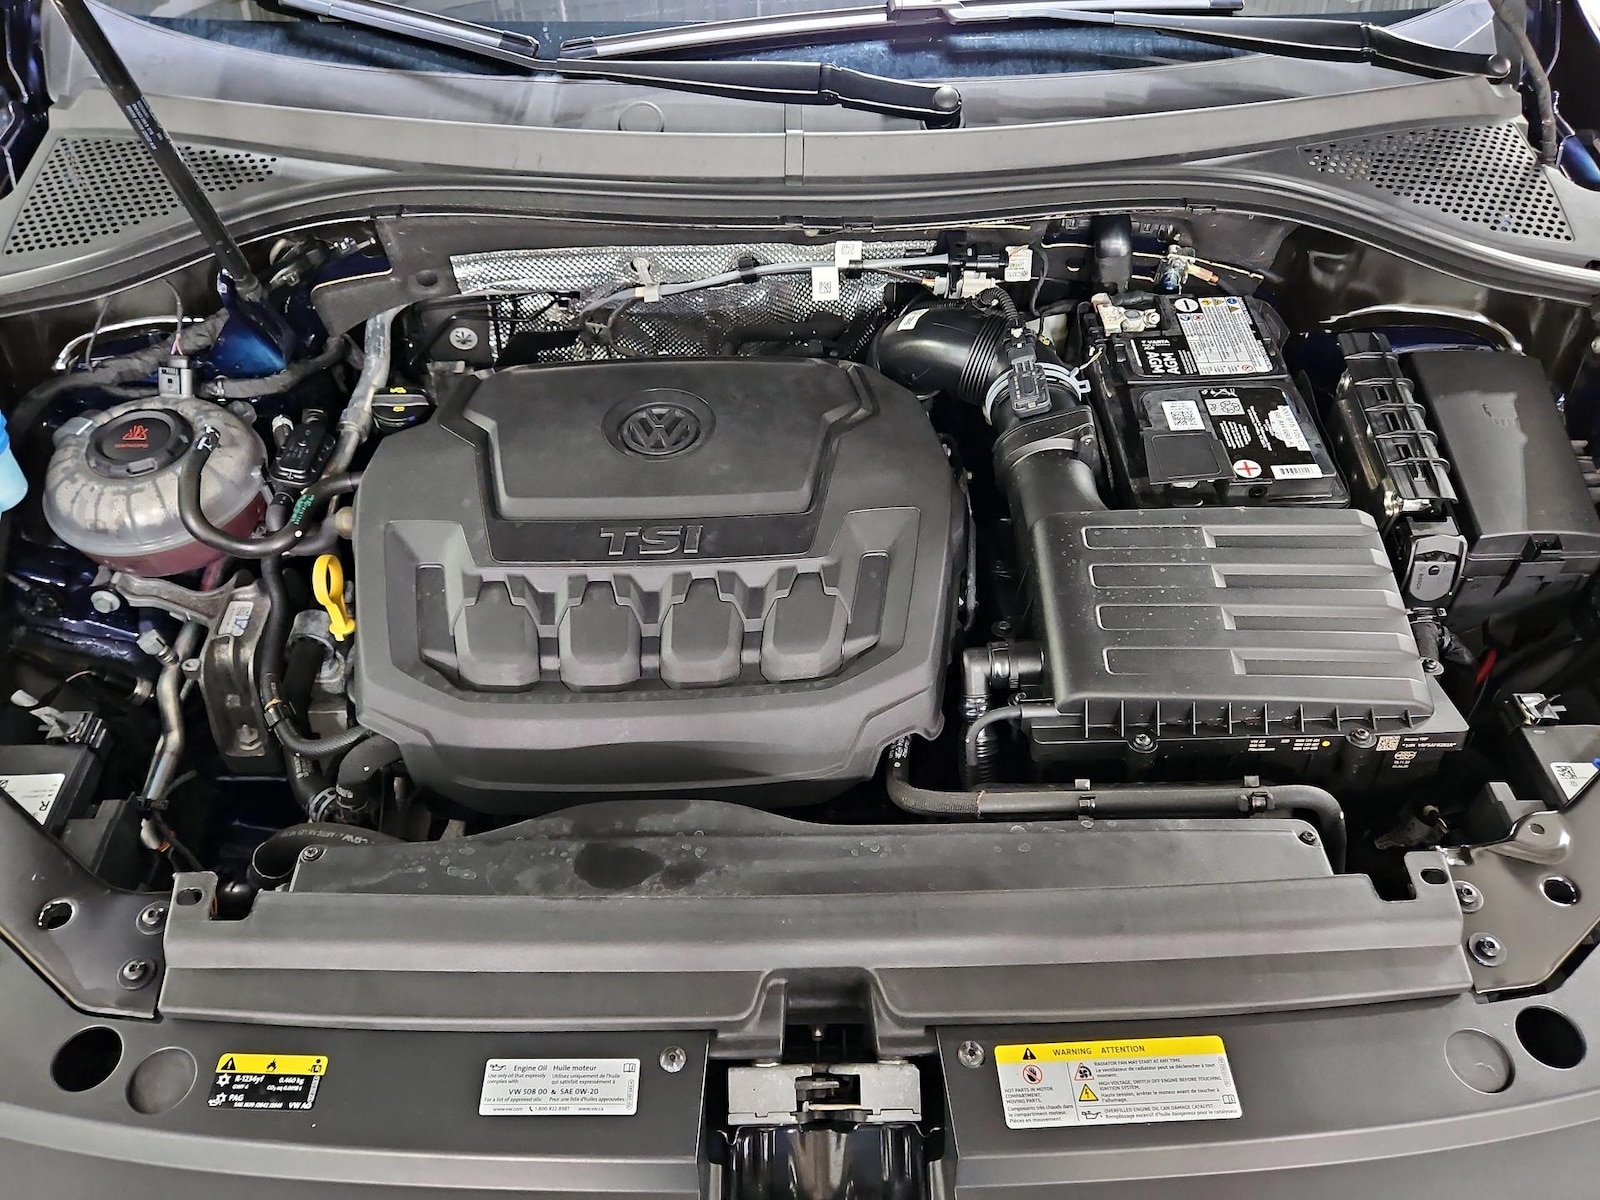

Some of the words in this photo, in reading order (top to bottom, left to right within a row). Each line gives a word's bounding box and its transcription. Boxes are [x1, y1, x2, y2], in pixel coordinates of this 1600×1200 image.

[1146, 351, 1165, 373] AGM
[1161, 352, 1181, 375] AGM
[622, 402, 702, 457] VW
[600, 525, 704, 555] TSI
[1052, 1047, 1092, 1056] WARNING
[1101, 1045, 1145, 1054] ATTENTION
[513, 1065, 537, 1073] Engine
[234, 1075, 265, 1084] R-1234yf
[228, 1094, 245, 1102] PAG
